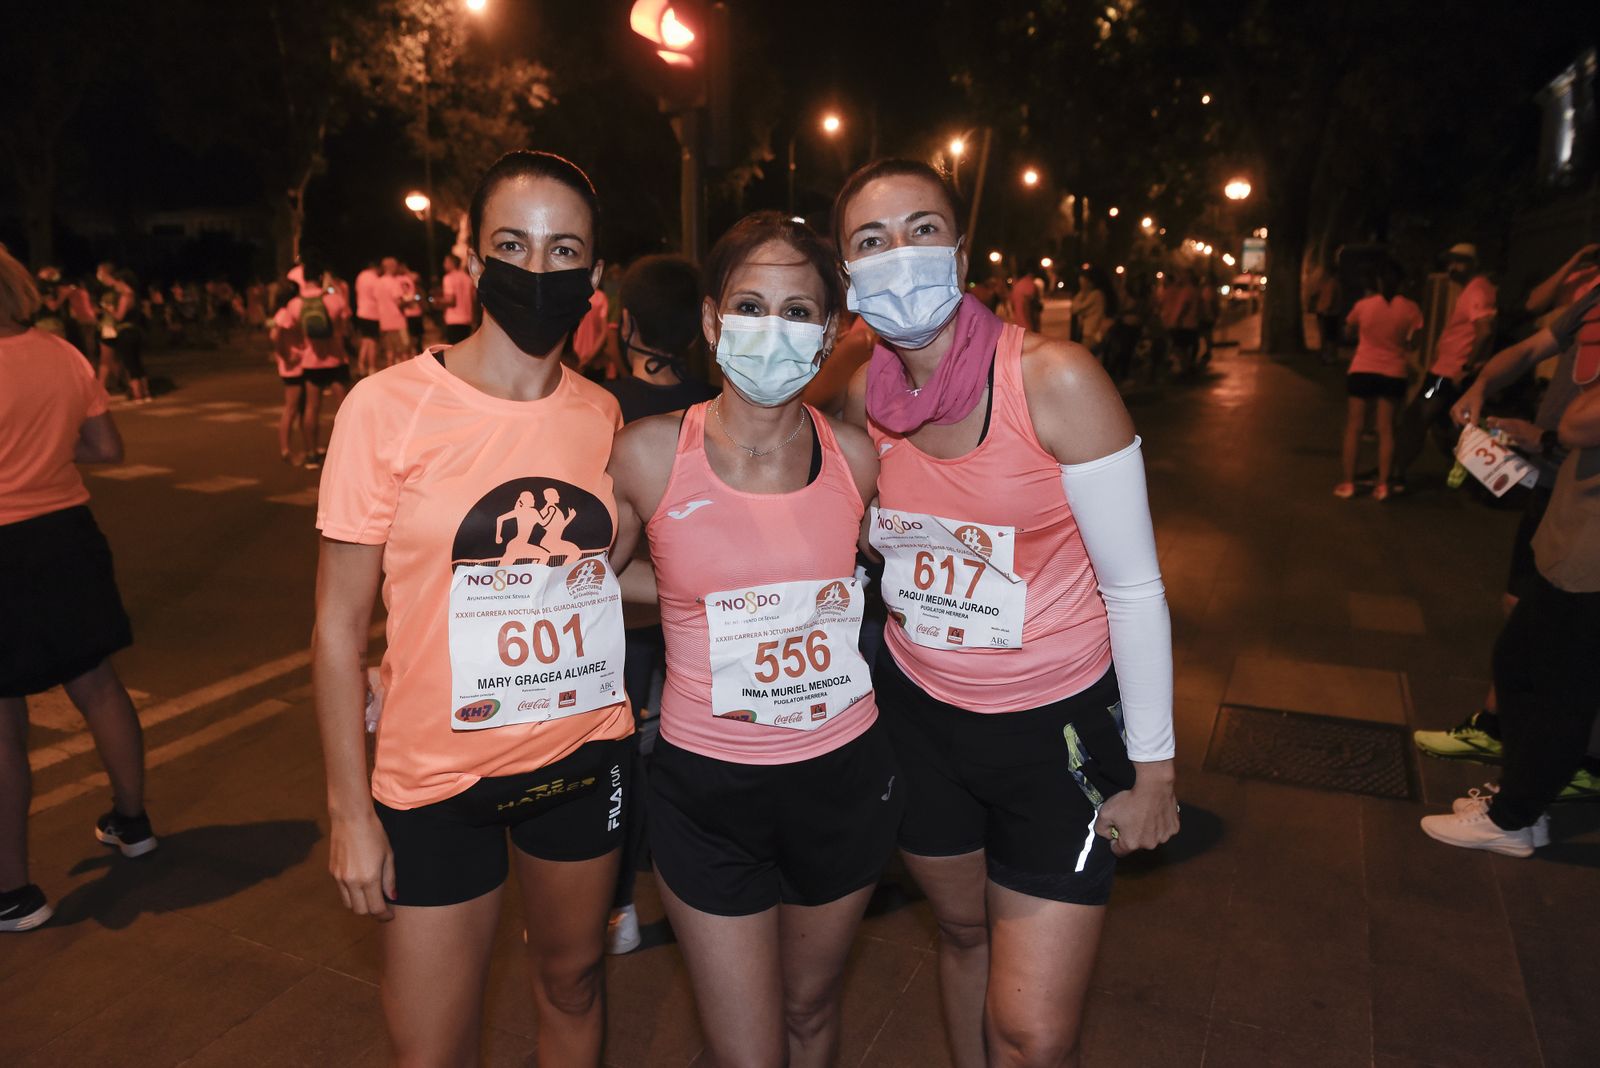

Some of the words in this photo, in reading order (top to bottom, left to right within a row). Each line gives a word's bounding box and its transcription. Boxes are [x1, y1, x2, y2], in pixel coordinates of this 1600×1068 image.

[913, 551, 986, 599] 617
[476, 610, 508, 618] CARRERA
[553, 599, 596, 612] GUADALQUIVIR
[898, 589, 924, 601] PAQUI
[925, 593, 957, 609] MEDINA
[959, 601, 1000, 616] JURADO
[920, 604, 945, 614] PUGILATOR
[945, 610, 969, 619] HERRERA
[497, 613, 585, 667] 601
[734, 631, 763, 640] CARRERA
[990, 636, 1009, 646] ABC
[754, 629, 831, 683] 556
[477, 676, 512, 690] MARY
[514, 670, 562, 686] GRAGEA
[564, 660, 607, 680] ALVAREZ
[600, 680, 615, 691] ABC
[742, 688, 768, 698] INMA
[771, 684, 807, 697] MURIEL
[808, 675, 851, 691] MENDOZA
[773, 694, 804, 705] PUGILATOR
[804, 691, 828, 701] HERRERA
[610, 764, 621, 787] run
[607, 787, 622, 832] FILA
